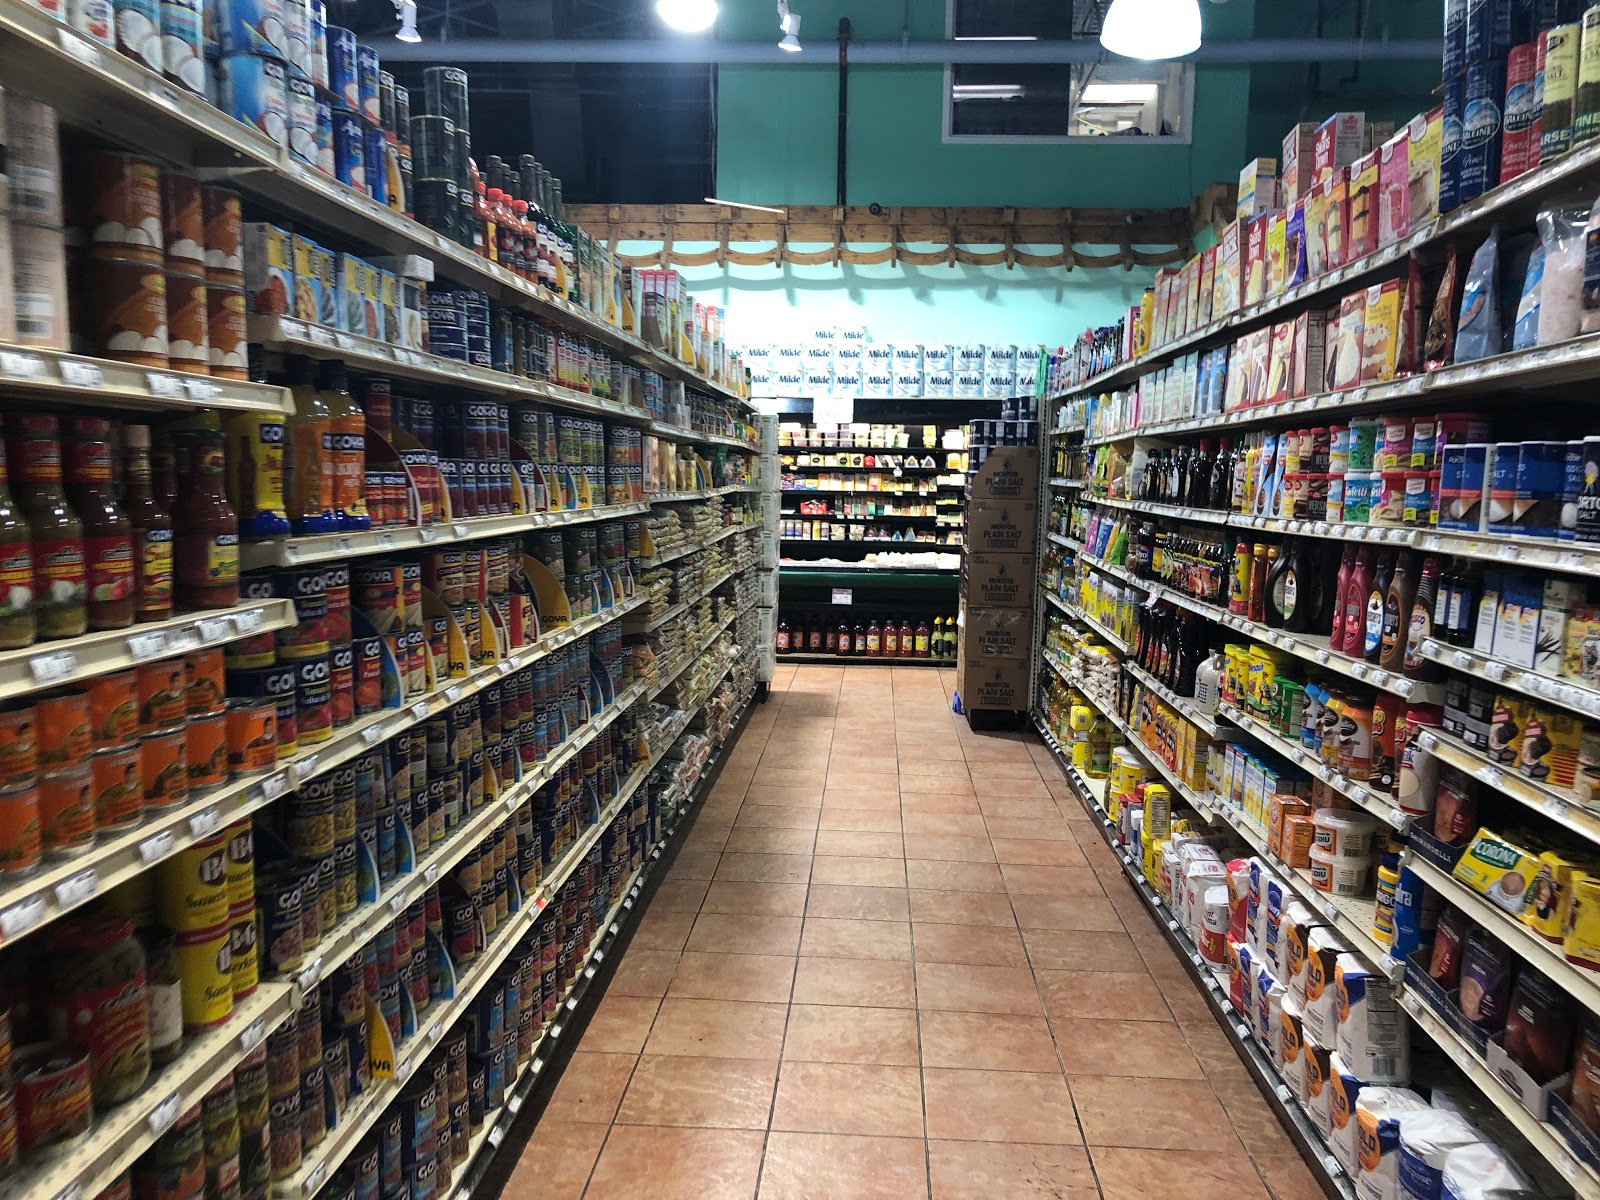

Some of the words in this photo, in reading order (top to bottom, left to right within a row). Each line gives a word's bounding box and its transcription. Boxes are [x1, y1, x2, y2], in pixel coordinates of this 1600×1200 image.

[815, 331, 835, 339] Milde
[843, 332, 864, 340] Milde
[749, 349, 770, 357] Milde
[780, 348, 802, 357] Milde
[808, 349, 830, 358] Milde
[838, 349, 860, 358] Milde
[868, 350, 891, 358] Milde
[896, 350, 919, 359] Milde
[925, 350, 947, 359] Milde
[961, 350, 983, 359] Milde
[991, 350, 1013, 359] Milde
[779, 375, 801, 384] Milde
[808, 375, 831, 384] Milde
[836, 376, 859, 385] Milde
[868, 376, 891, 385] Milde
[898, 376, 921, 385] Milde
[930, 376, 951, 386] Milde
[959, 376, 982, 386] Milde
[990, 376, 1012, 386] Milde
[986, 478, 1005, 486] PLAIN
[1008, 478, 1024, 486] SALT
[1006, 530, 1022, 538] SALT
[981, 584, 1001, 592] PLAIN
[1003, 584, 1019, 592] SALT
[542, 615, 568, 623] GOYA
[978, 637, 999, 645] PLAIN
[1000, 637, 1016, 645] SALT
[302, 662, 330, 682] GO
[266, 673, 295, 693] GO
[978, 687, 998, 696] PLAIN
[999, 687, 1015, 696] SALT
[521, 721, 534, 733] GO
[1474, 842, 1518, 866] CORONA
